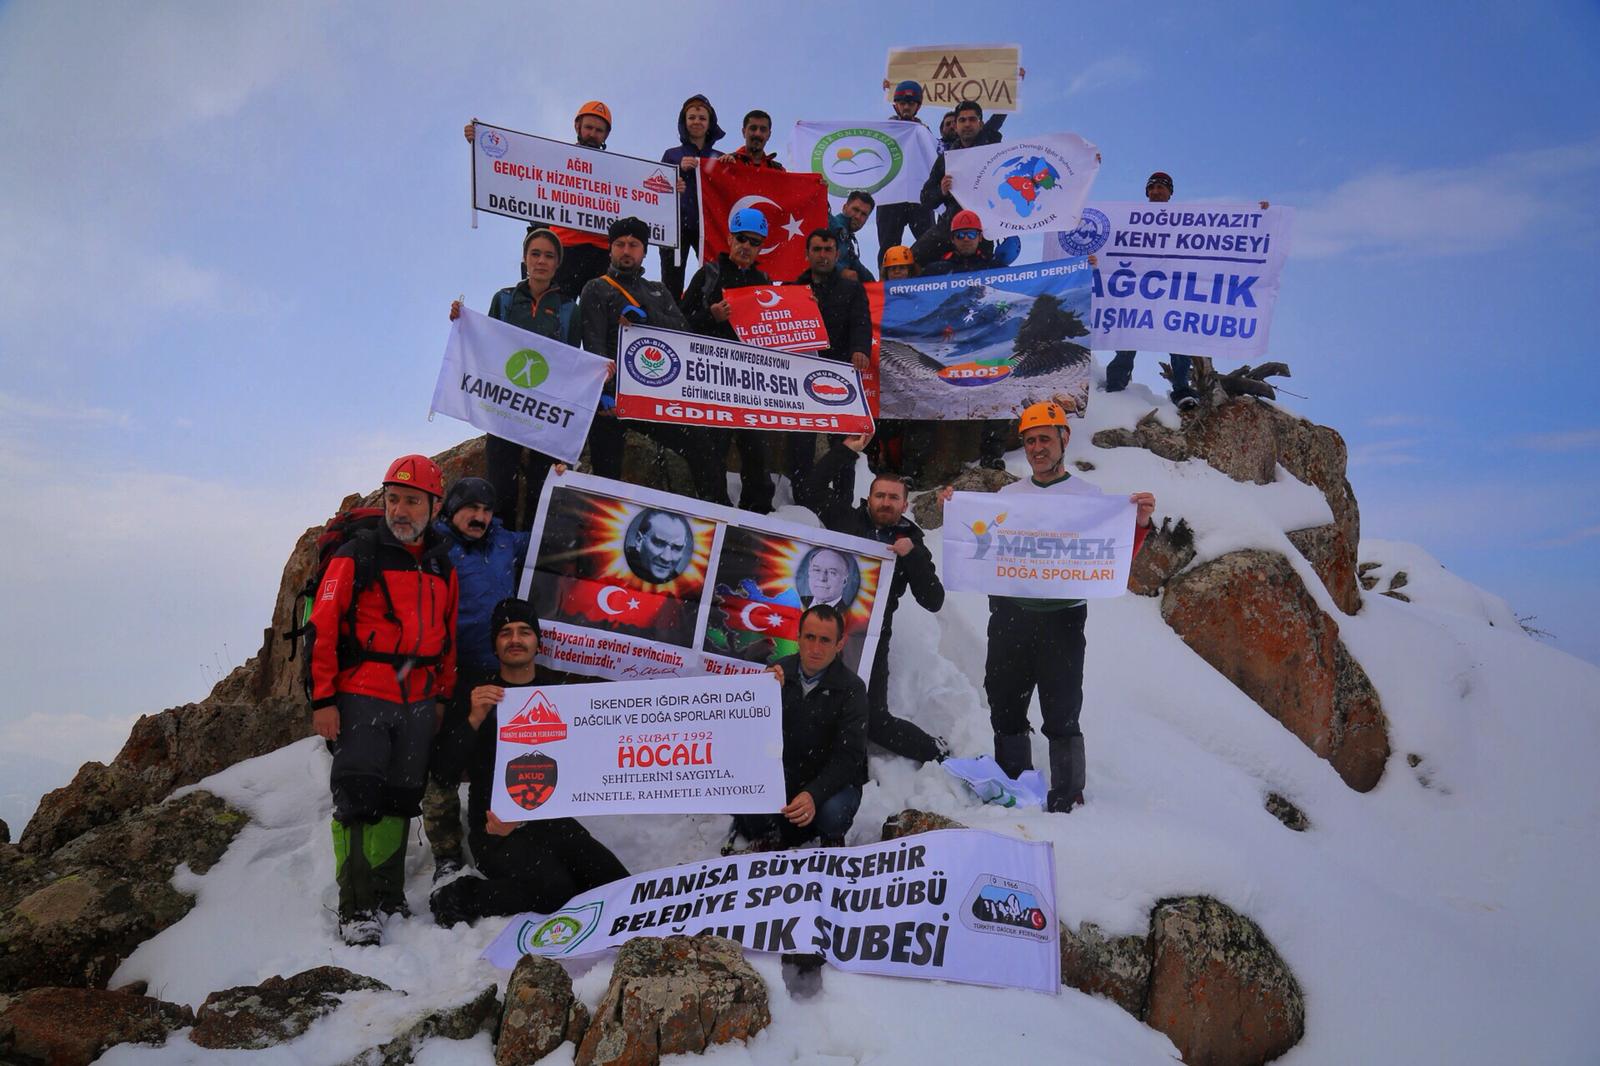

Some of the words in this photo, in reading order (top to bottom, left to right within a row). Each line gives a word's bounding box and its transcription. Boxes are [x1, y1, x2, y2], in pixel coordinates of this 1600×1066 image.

[921, 79, 1012, 104] ARKOVA
[566, 158, 593, 174] AĞRI
[494, 160, 543, 182] GENÇLİK
[546, 172, 612, 194] HİZMETLERİ
[614, 186, 628, 199] VE
[631, 190, 659, 206] SPOR
[489, 194, 555, 222] DAĞCILIK
[560, 205, 572, 225] İL
[537, 186, 548, 200] İL
[551, 191, 620, 214] MÜDÜRLÜĞÜ
[1128, 208, 1262, 229] DOĞUBAYAZIT
[1114, 230, 1171, 249] KENT
[1175, 233, 1270, 254] KONSEYİ
[889, 281, 948, 296] ARYKANDA
[950, 276, 982, 289] DOĞA
[984, 269, 1038, 285] SPORLARI
[1092, 260, 1260, 308] AĞCILIK
[736, 324, 748, 336] İL
[750, 322, 774, 335] GÖÇ
[776, 317, 820, 332] İDARESİ
[760, 308, 792, 321] IĞDIR
[1163, 310, 1258, 340] GRUBU
[746, 328, 816, 346] MÜDÜRLÜĞÜ
[690, 342, 729, 360] MEMUR-SEN
[730, 349, 790, 370] KONFEDERASYONU
[686, 358, 799, 396] EĞİTİM-BİR-SEN
[460, 372, 576, 428] KAMPEREST
[682, 386, 732, 402] EĞİTİMCİLER
[734, 393, 762, 406] BİRLİĞİ
[764, 398, 805, 410] SENDİKASI
[655, 402, 734, 422] IĞDIR
[744, 414, 839, 428] ŞUBESİ
[996, 534, 1116, 560] MASMEK
[996, 565, 1038, 580] DOĞA
[1042, 568, 1114, 580] SPORLARI
[540, 626, 595, 649] zerbaycan'ın
[597, 638, 632, 655] sevinci
[632, 646, 684, 668] sevincimiz,
[590, 698, 652, 710] İSKENDER
[656, 695, 689, 706] IĞDIR
[692, 692, 722, 704] AĞRI
[725, 690, 756, 703] DAĞI
[574, 713, 622, 726] DAĞCILIK
[624, 714, 638, 725] VE
[641, 710, 672, 724] DOĞA
[674, 710, 726, 722] SPORLARI
[728, 706, 771, 719] KULÜBÜ
[618, 735, 633, 744] 26
[684, 731, 713, 742] 1992
[618, 742, 712, 768] HOCALI
[518, 772, 544, 780] AKUD
[602, 770, 673, 786] ŞEHİTLERİNİ
[638, 788, 702, 800] RAHMETLE
[704, 784, 766, 796] ANIYORUZ
[630, 863, 740, 905] MANİSA
[748, 843, 926, 884] BÜYÜKŞEHİR
[608, 890, 738, 937] BELEDİYE
[745, 882, 824, 908] SPOR
[831, 871, 948, 913] KULÜBÜ
[812, 912, 951, 968] ŞUBESİ
